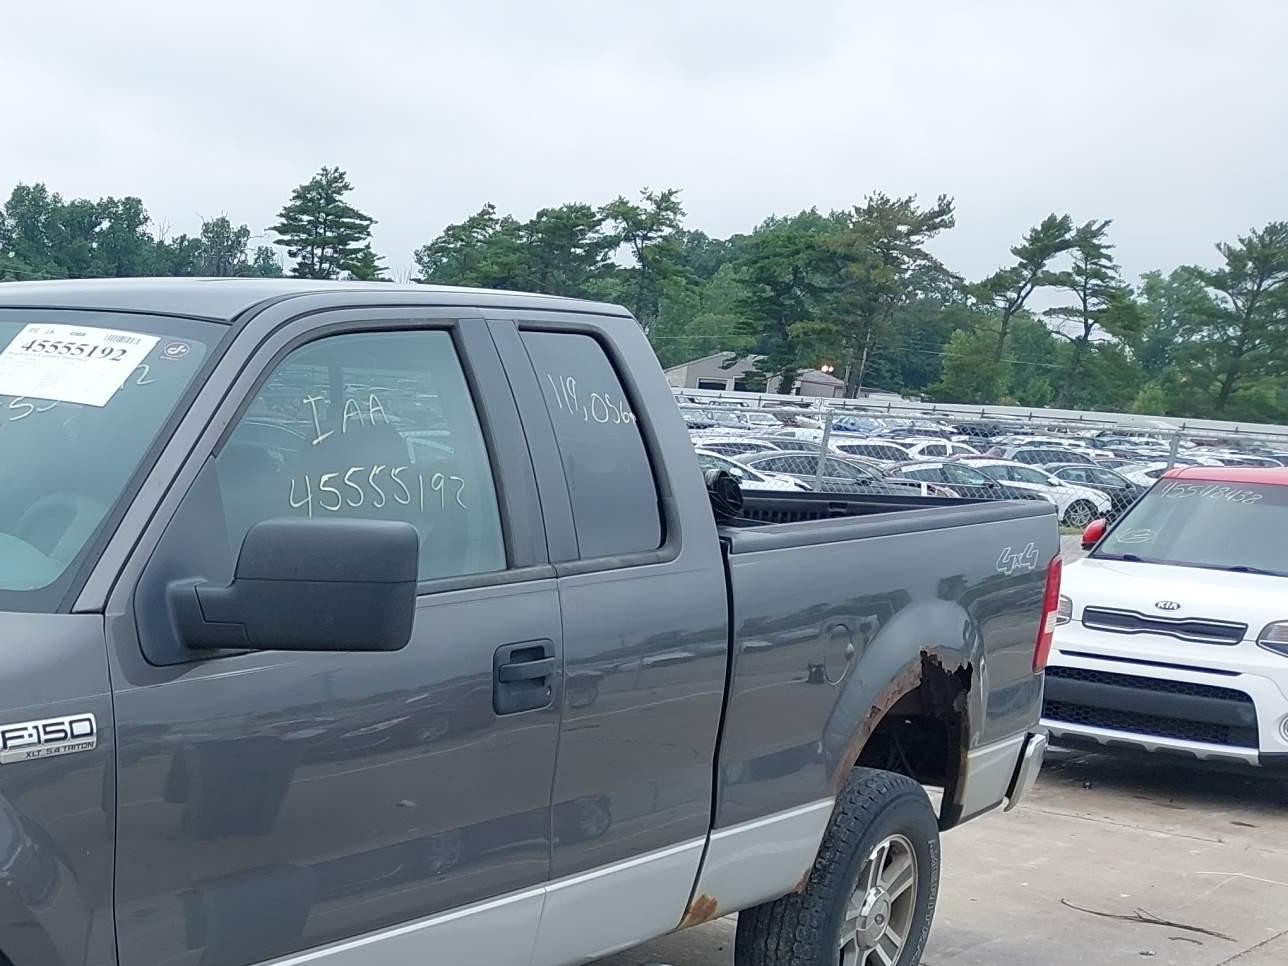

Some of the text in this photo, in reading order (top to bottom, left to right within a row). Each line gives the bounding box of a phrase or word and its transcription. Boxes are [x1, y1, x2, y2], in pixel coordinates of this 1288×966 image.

[21, 339, 128, 362] 45555192
[302, 393, 390, 445] IAA
[289, 464, 467, 518] 45555192
[995, 542, 1039, 576] 4x4
[1157, 600, 1179, 610] KIA
[25, 749, 42, 759] XLT
[62, 741, 94, 753] TRITON
